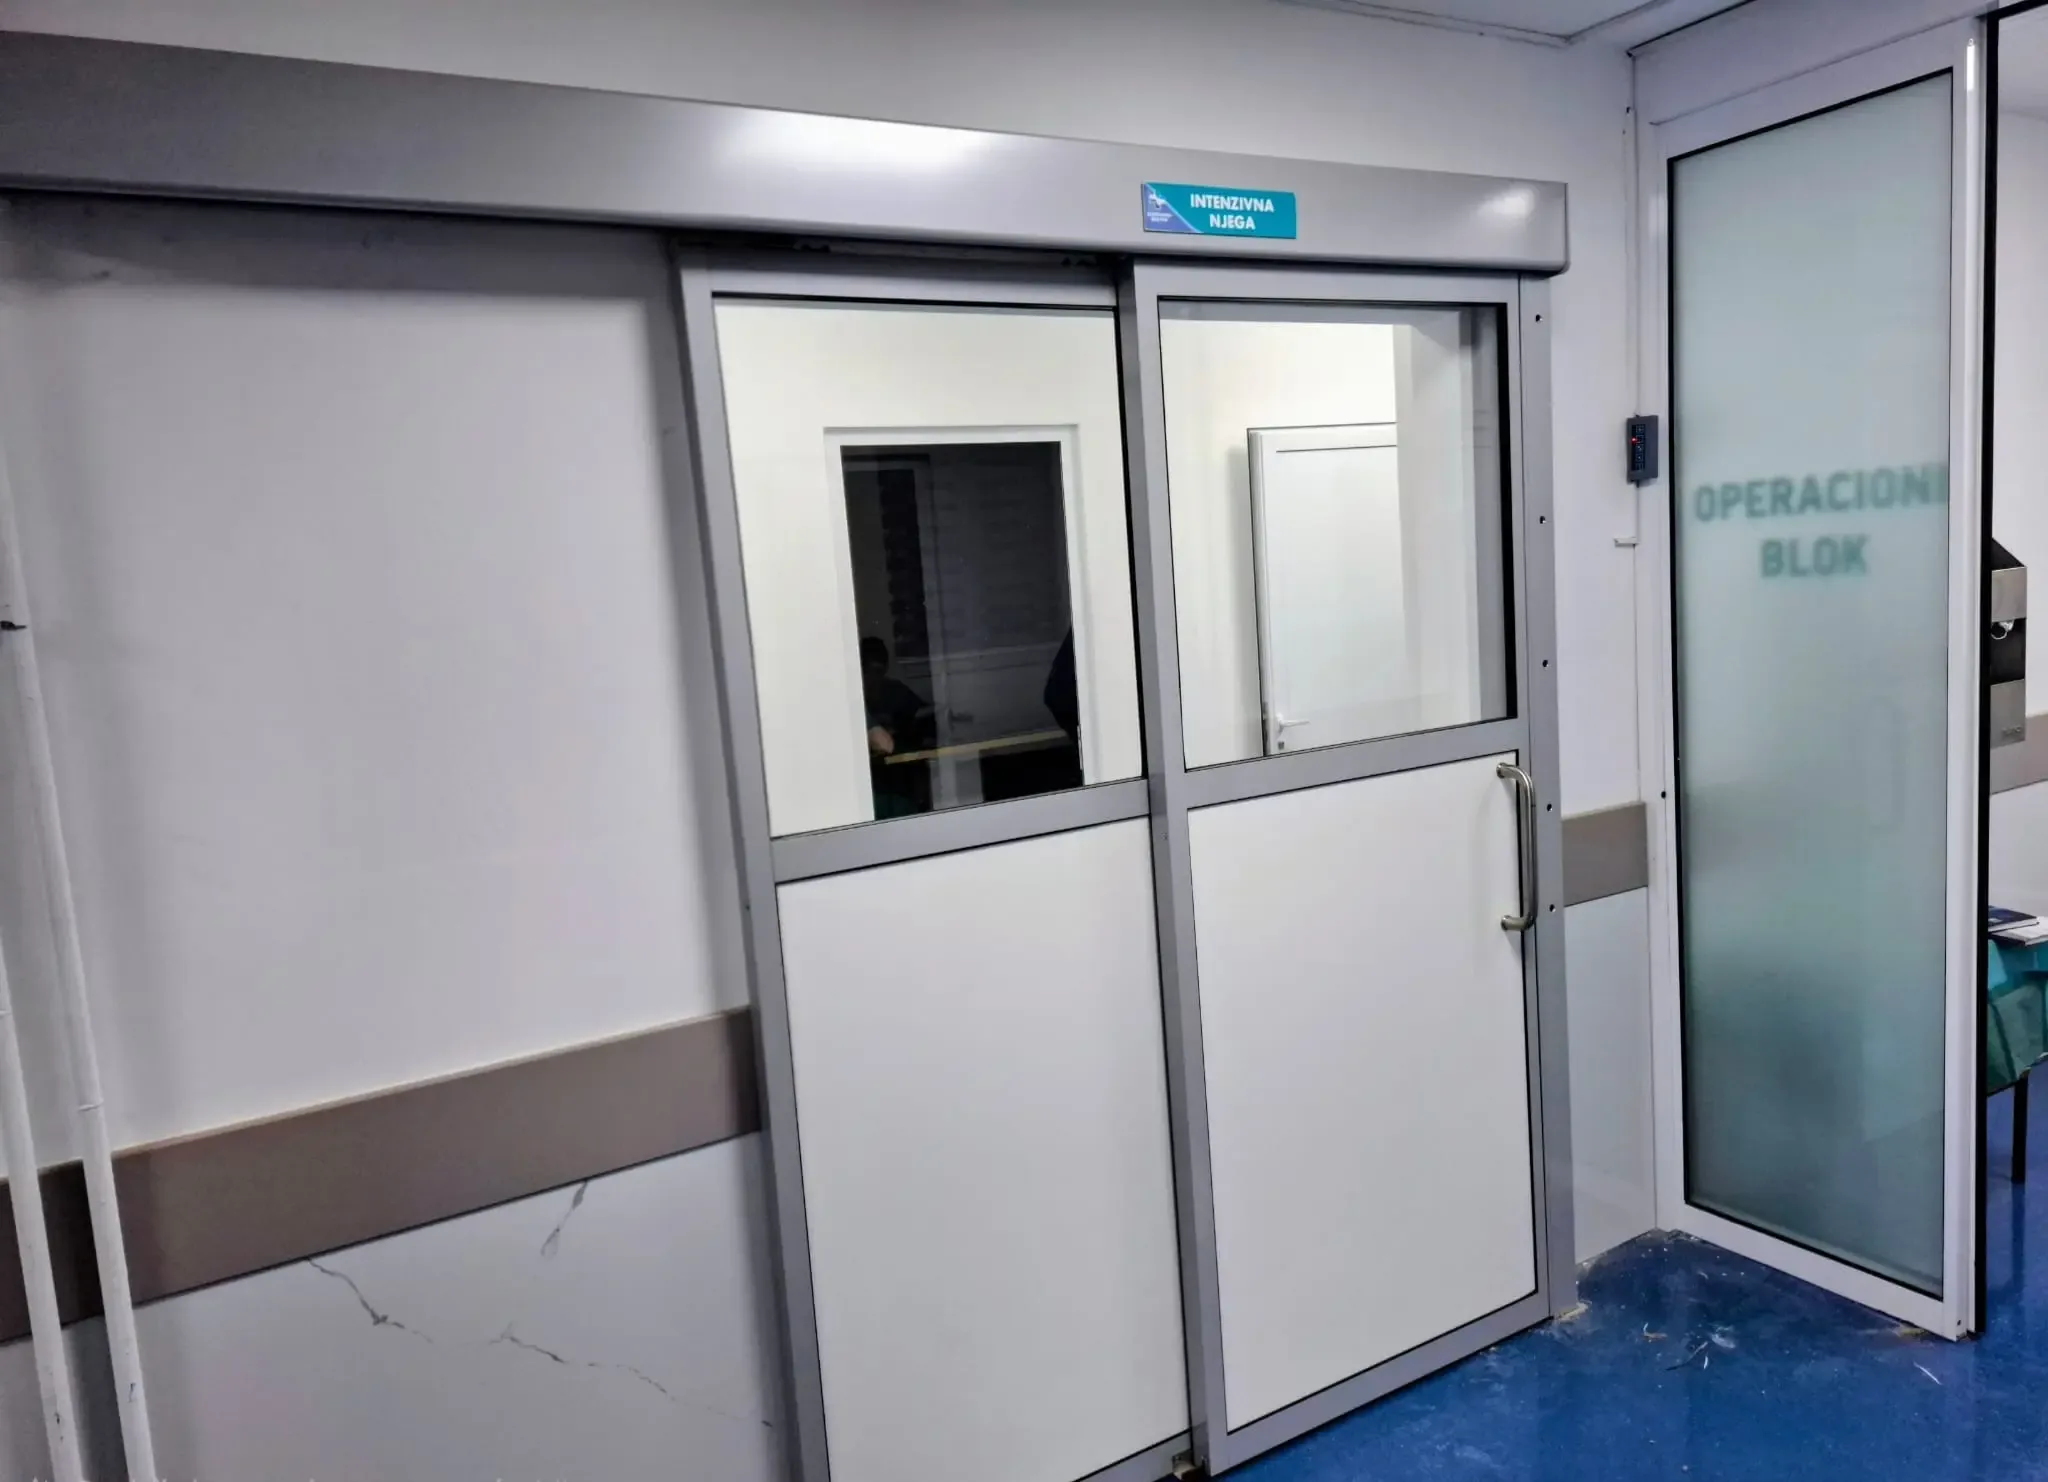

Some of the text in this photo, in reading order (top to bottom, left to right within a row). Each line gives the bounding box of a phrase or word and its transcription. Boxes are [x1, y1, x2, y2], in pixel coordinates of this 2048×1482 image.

[1190, 193, 1275, 213] INTENZIVNA
[1209, 213, 1256, 230] NJEGA
[1694, 464, 1948, 522] OPERACIONI
[1760, 535, 1868, 578] BLOK
